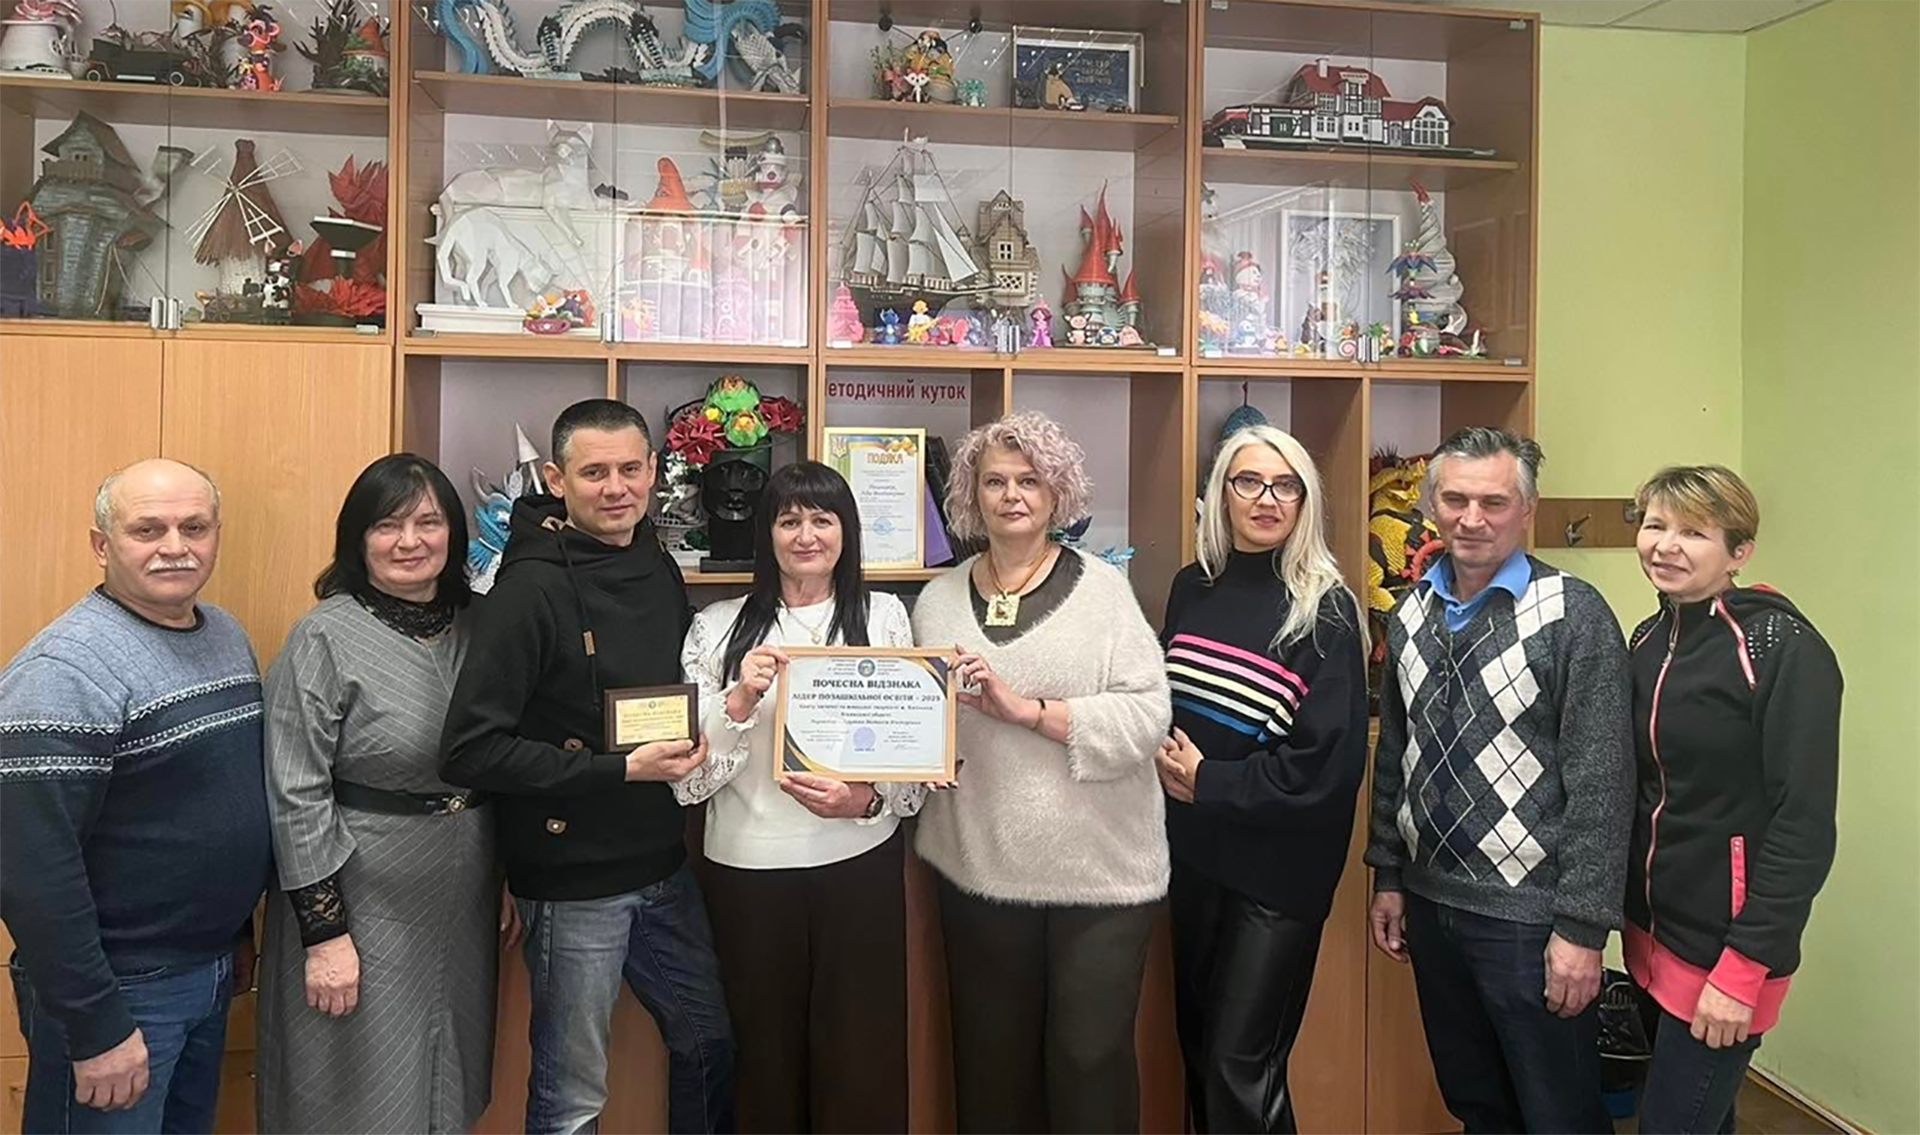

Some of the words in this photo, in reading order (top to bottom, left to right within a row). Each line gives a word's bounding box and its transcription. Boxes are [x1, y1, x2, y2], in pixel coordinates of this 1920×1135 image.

[825, 378, 915, 400] етодичний
[921, 385, 966, 404] куток
[867, 453, 904, 465] ПОДЯКА
[812, 679, 864, 688] ПОЧЕСНА
[867, 680, 921, 689] ВІДЗНАКА
